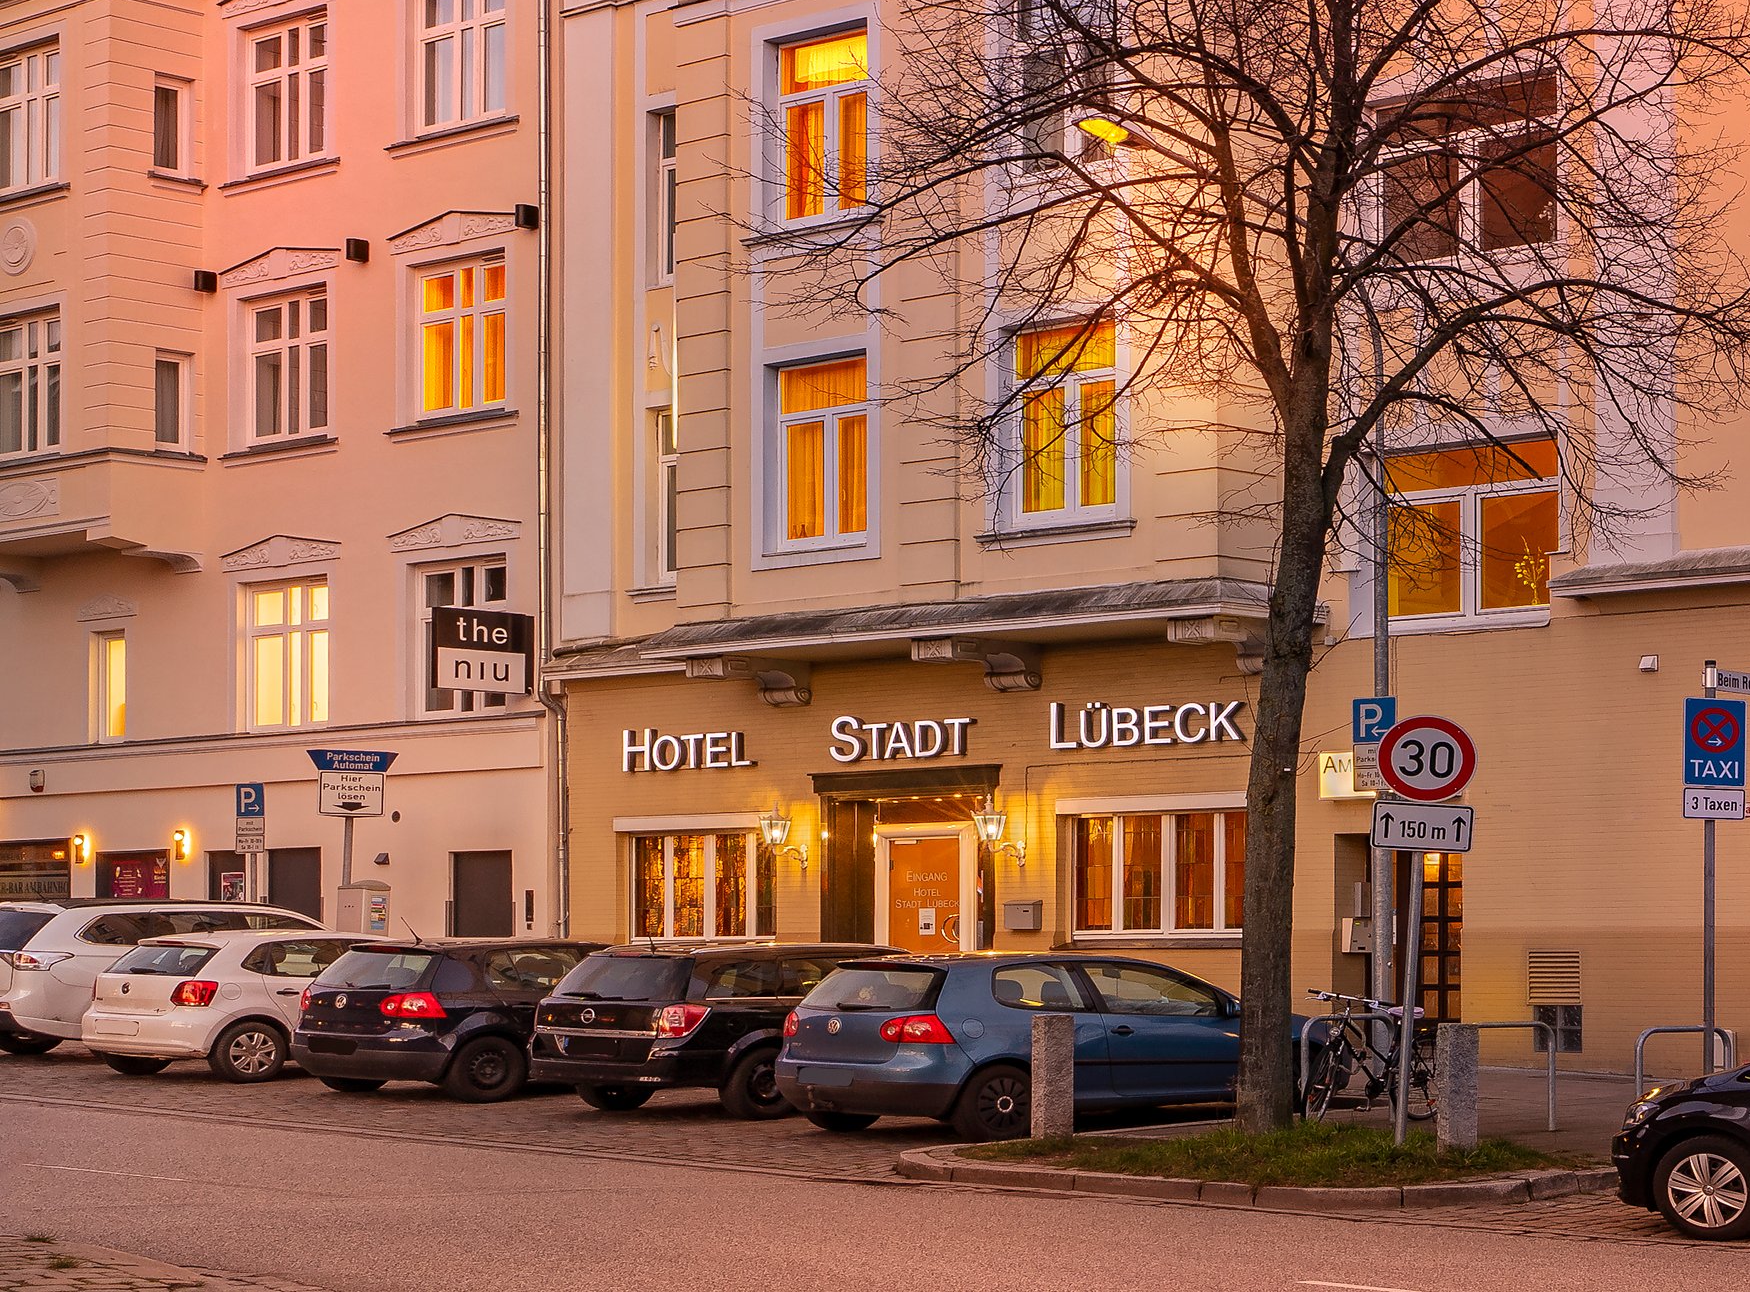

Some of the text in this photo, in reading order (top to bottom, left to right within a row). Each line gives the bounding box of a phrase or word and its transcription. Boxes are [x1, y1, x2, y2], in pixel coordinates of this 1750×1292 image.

[456, 617, 508, 644] the
[1718, 672, 1740, 688] Beim
[621, 700, 1246, 773] HOTEL STADT LÜBECK
[327, 752, 380, 762] Parkschein
[1398, 739, 1455, 779] 30
[332, 761, 374, 770] Automat
[1690, 759, 1739, 779] TAXI
[340, 774, 363, 783] Hier
[323, 783, 381, 792] Parkschein
[337, 792, 366, 800] lösen
[1691, 796, 1738, 812] 3 Taxen
[1400, 820, 1446, 840] 150 m
